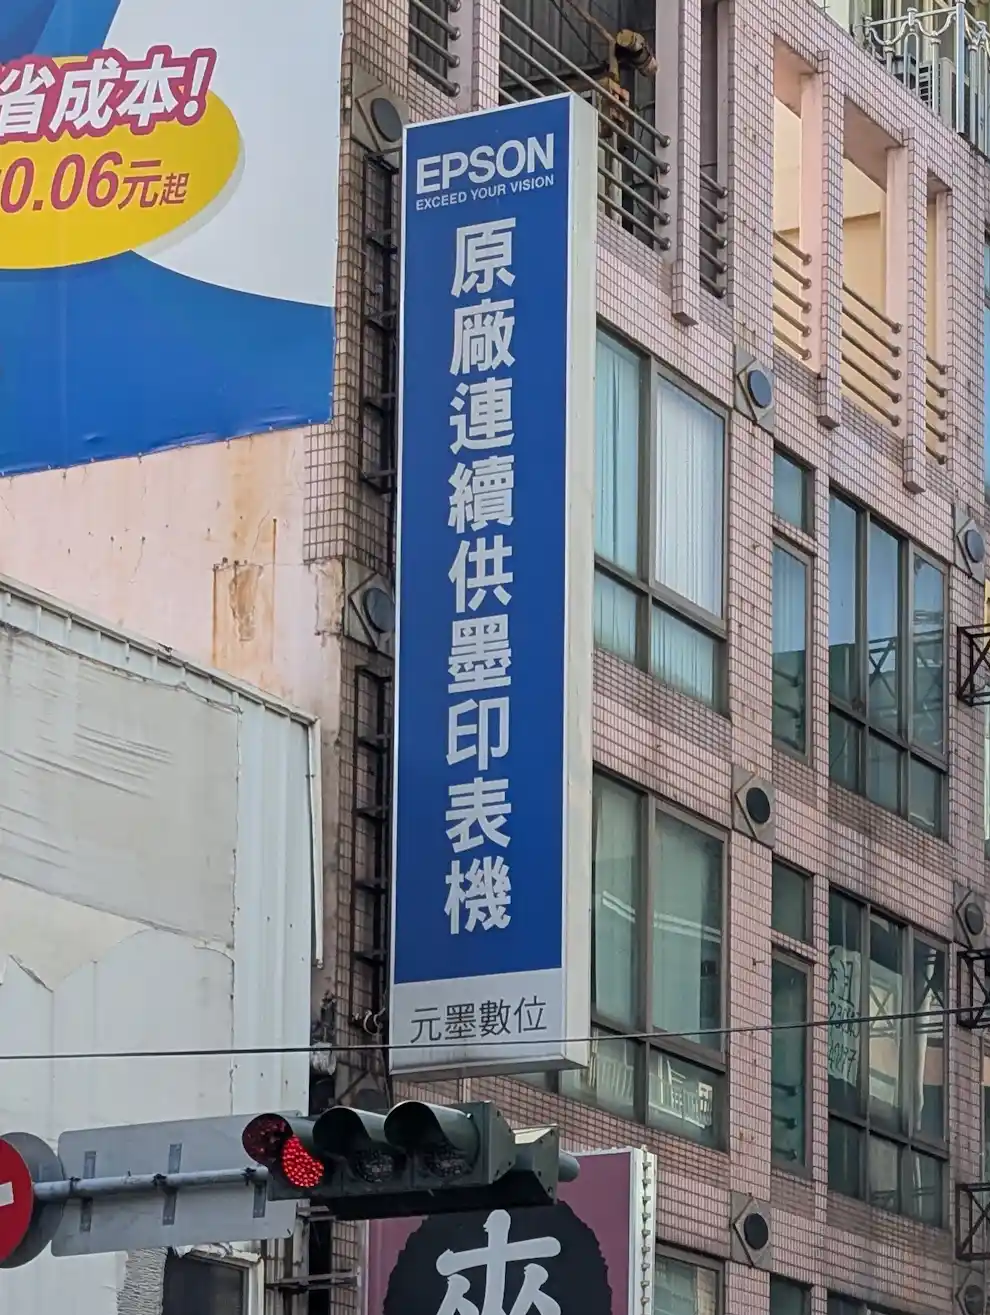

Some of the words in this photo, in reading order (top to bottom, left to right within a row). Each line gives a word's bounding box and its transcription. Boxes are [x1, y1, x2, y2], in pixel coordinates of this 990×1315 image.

[0, 151, 189, 213] 0.06元起
[415, 133, 555, 195] EPSON
[416, 192, 466, 211] EXCEED
[471, 184, 507, 203] YOUR
[510, 174, 555, 196] VISION
[444, 217, 516, 935] 原廠連續供墨印表機
[410, 994, 547, 1044] 元墨數位
